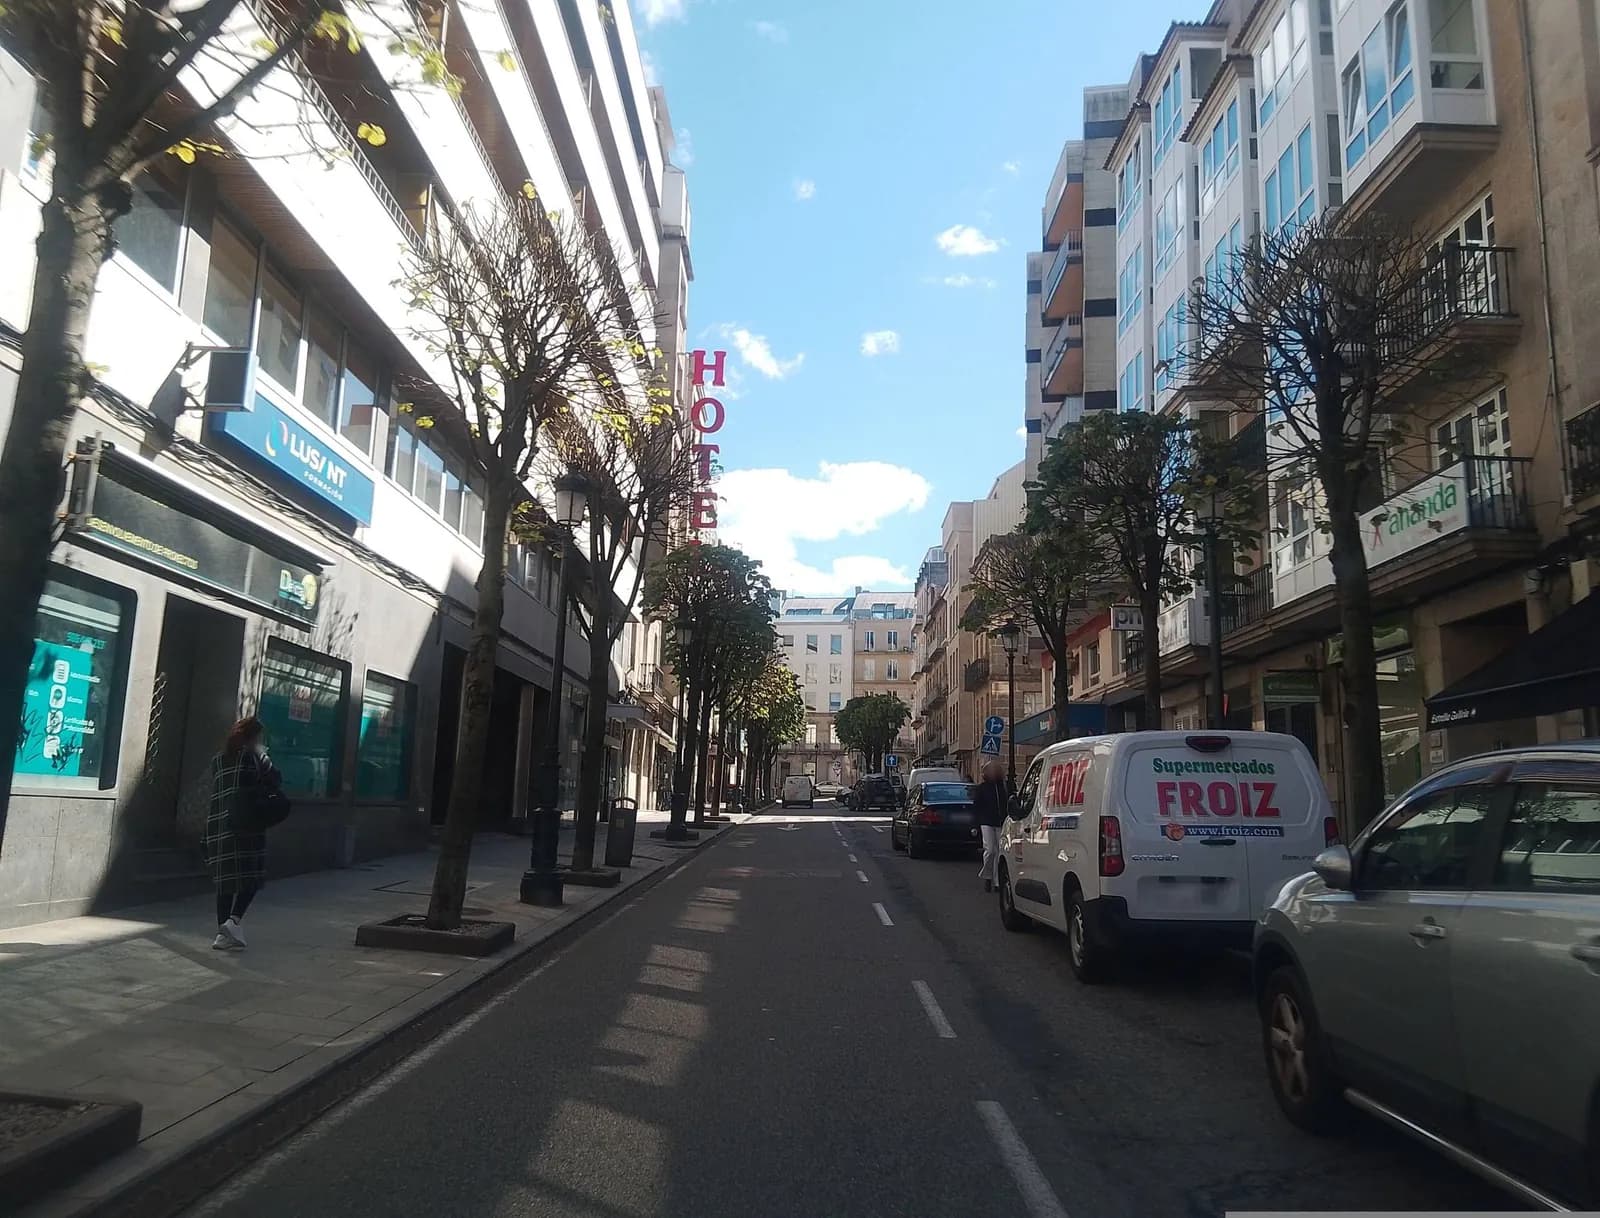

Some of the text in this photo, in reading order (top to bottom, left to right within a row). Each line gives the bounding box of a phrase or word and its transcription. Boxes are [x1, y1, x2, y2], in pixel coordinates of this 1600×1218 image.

[690, 350, 726, 548] HOTE
[1152, 757, 1276, 776] Supermercados
[1156, 781, 1280, 818] FROIZ
[1186, 825, 1281, 837] www.froiz.com
